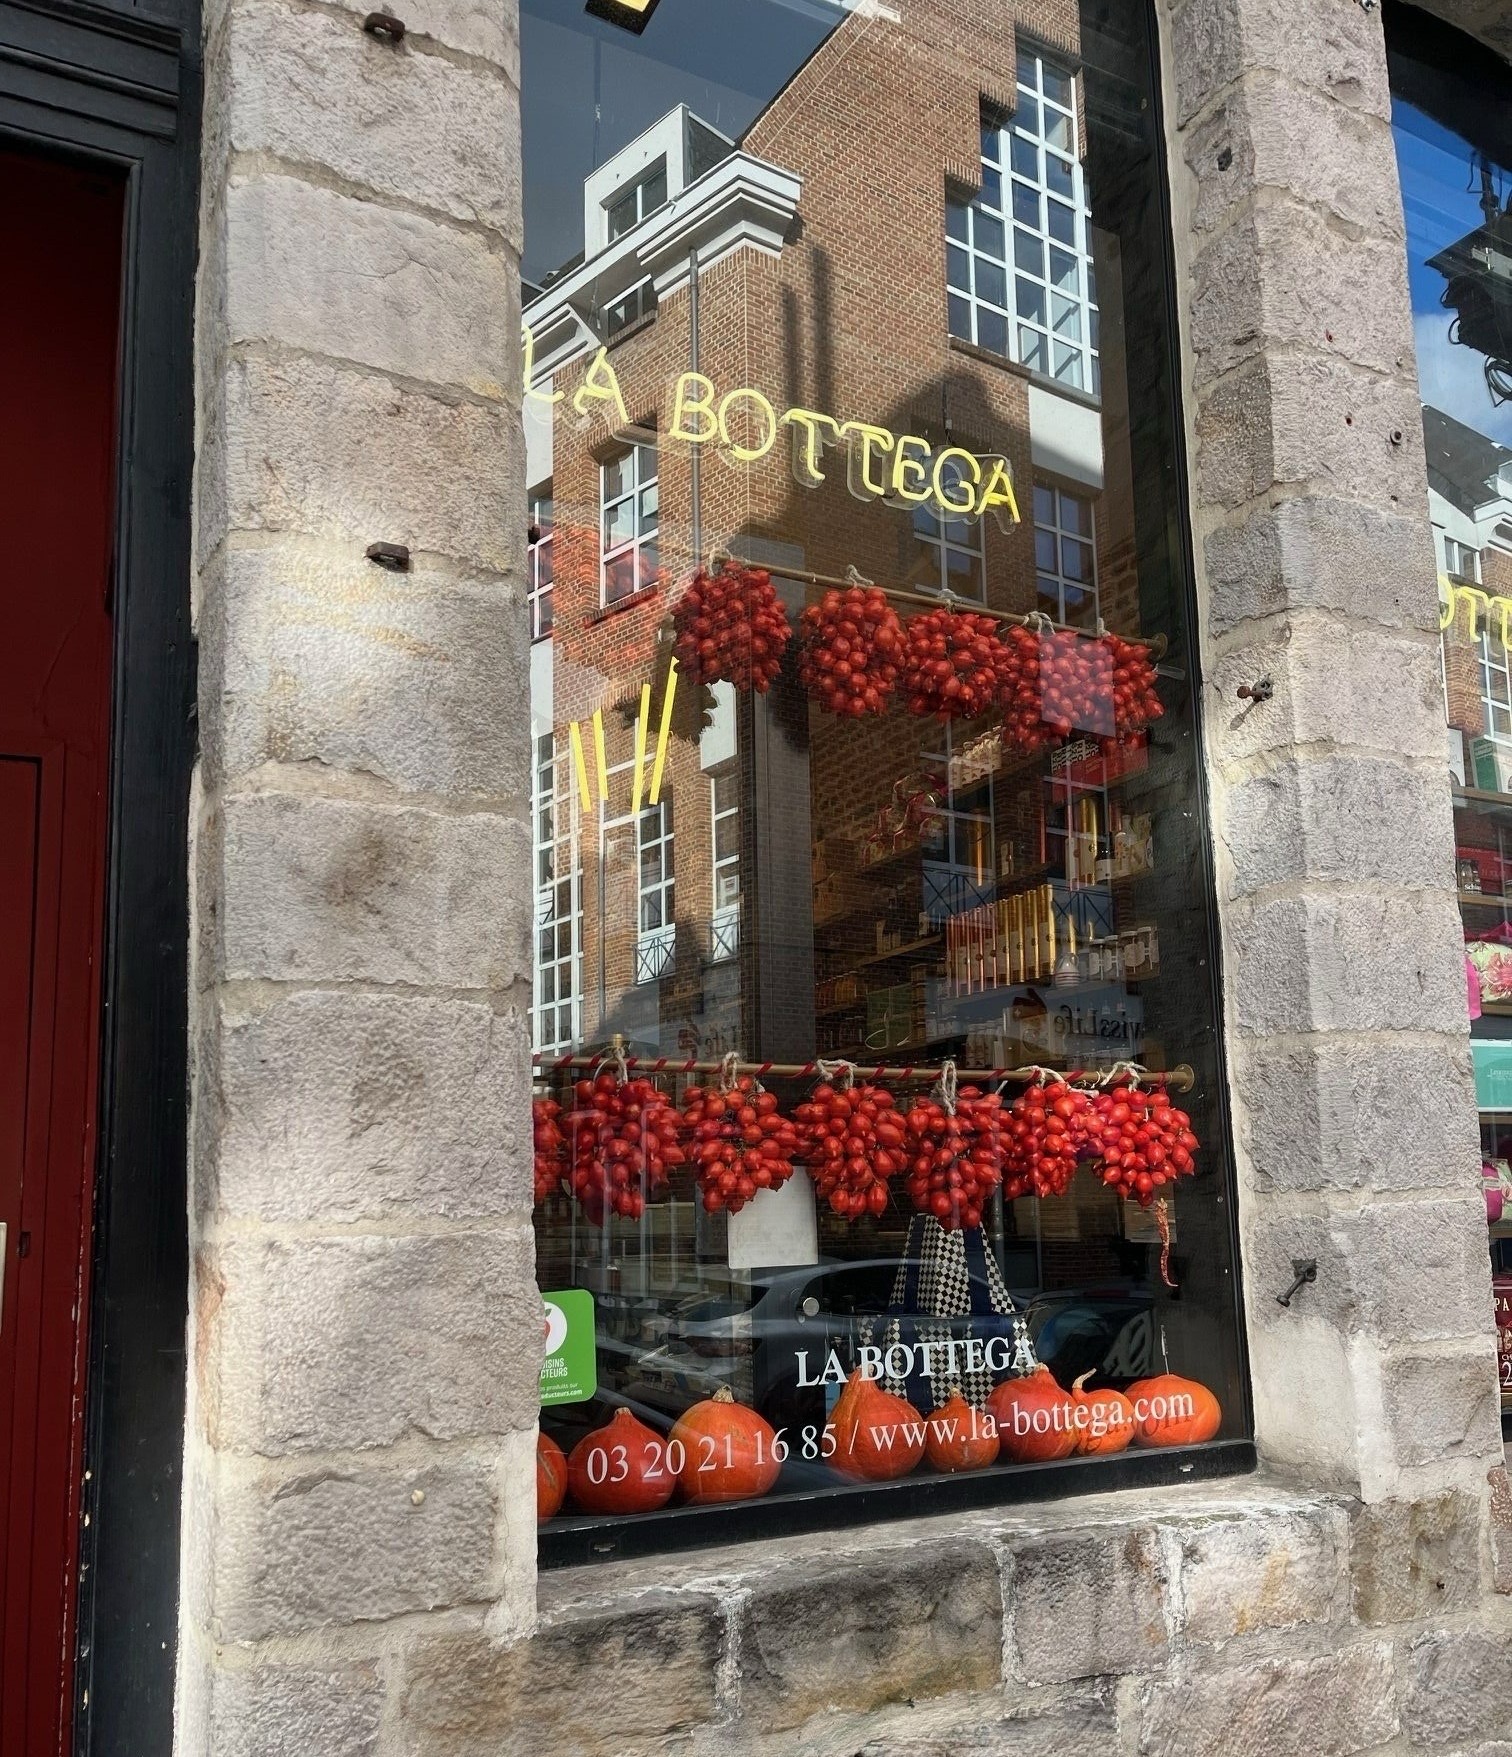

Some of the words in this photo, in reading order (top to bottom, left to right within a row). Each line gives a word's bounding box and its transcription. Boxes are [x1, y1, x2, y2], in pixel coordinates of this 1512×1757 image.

[522, 324, 633, 423] LA
[669, 372, 1021, 523] BOTTEGA
[794, 1348, 850, 1388] LA
[857, 1335, 1038, 1383] BOTTEGA
[586, 1444, 630, 1485] 03
[643, 1439, 687, 1478] 20
[697, 1434, 736, 1472] 21
[753, 1427, 790, 1465] 16
[801, 1423, 838, 1460] 85
[868, 1391, 1195, 1452] www.la-bottega.com
